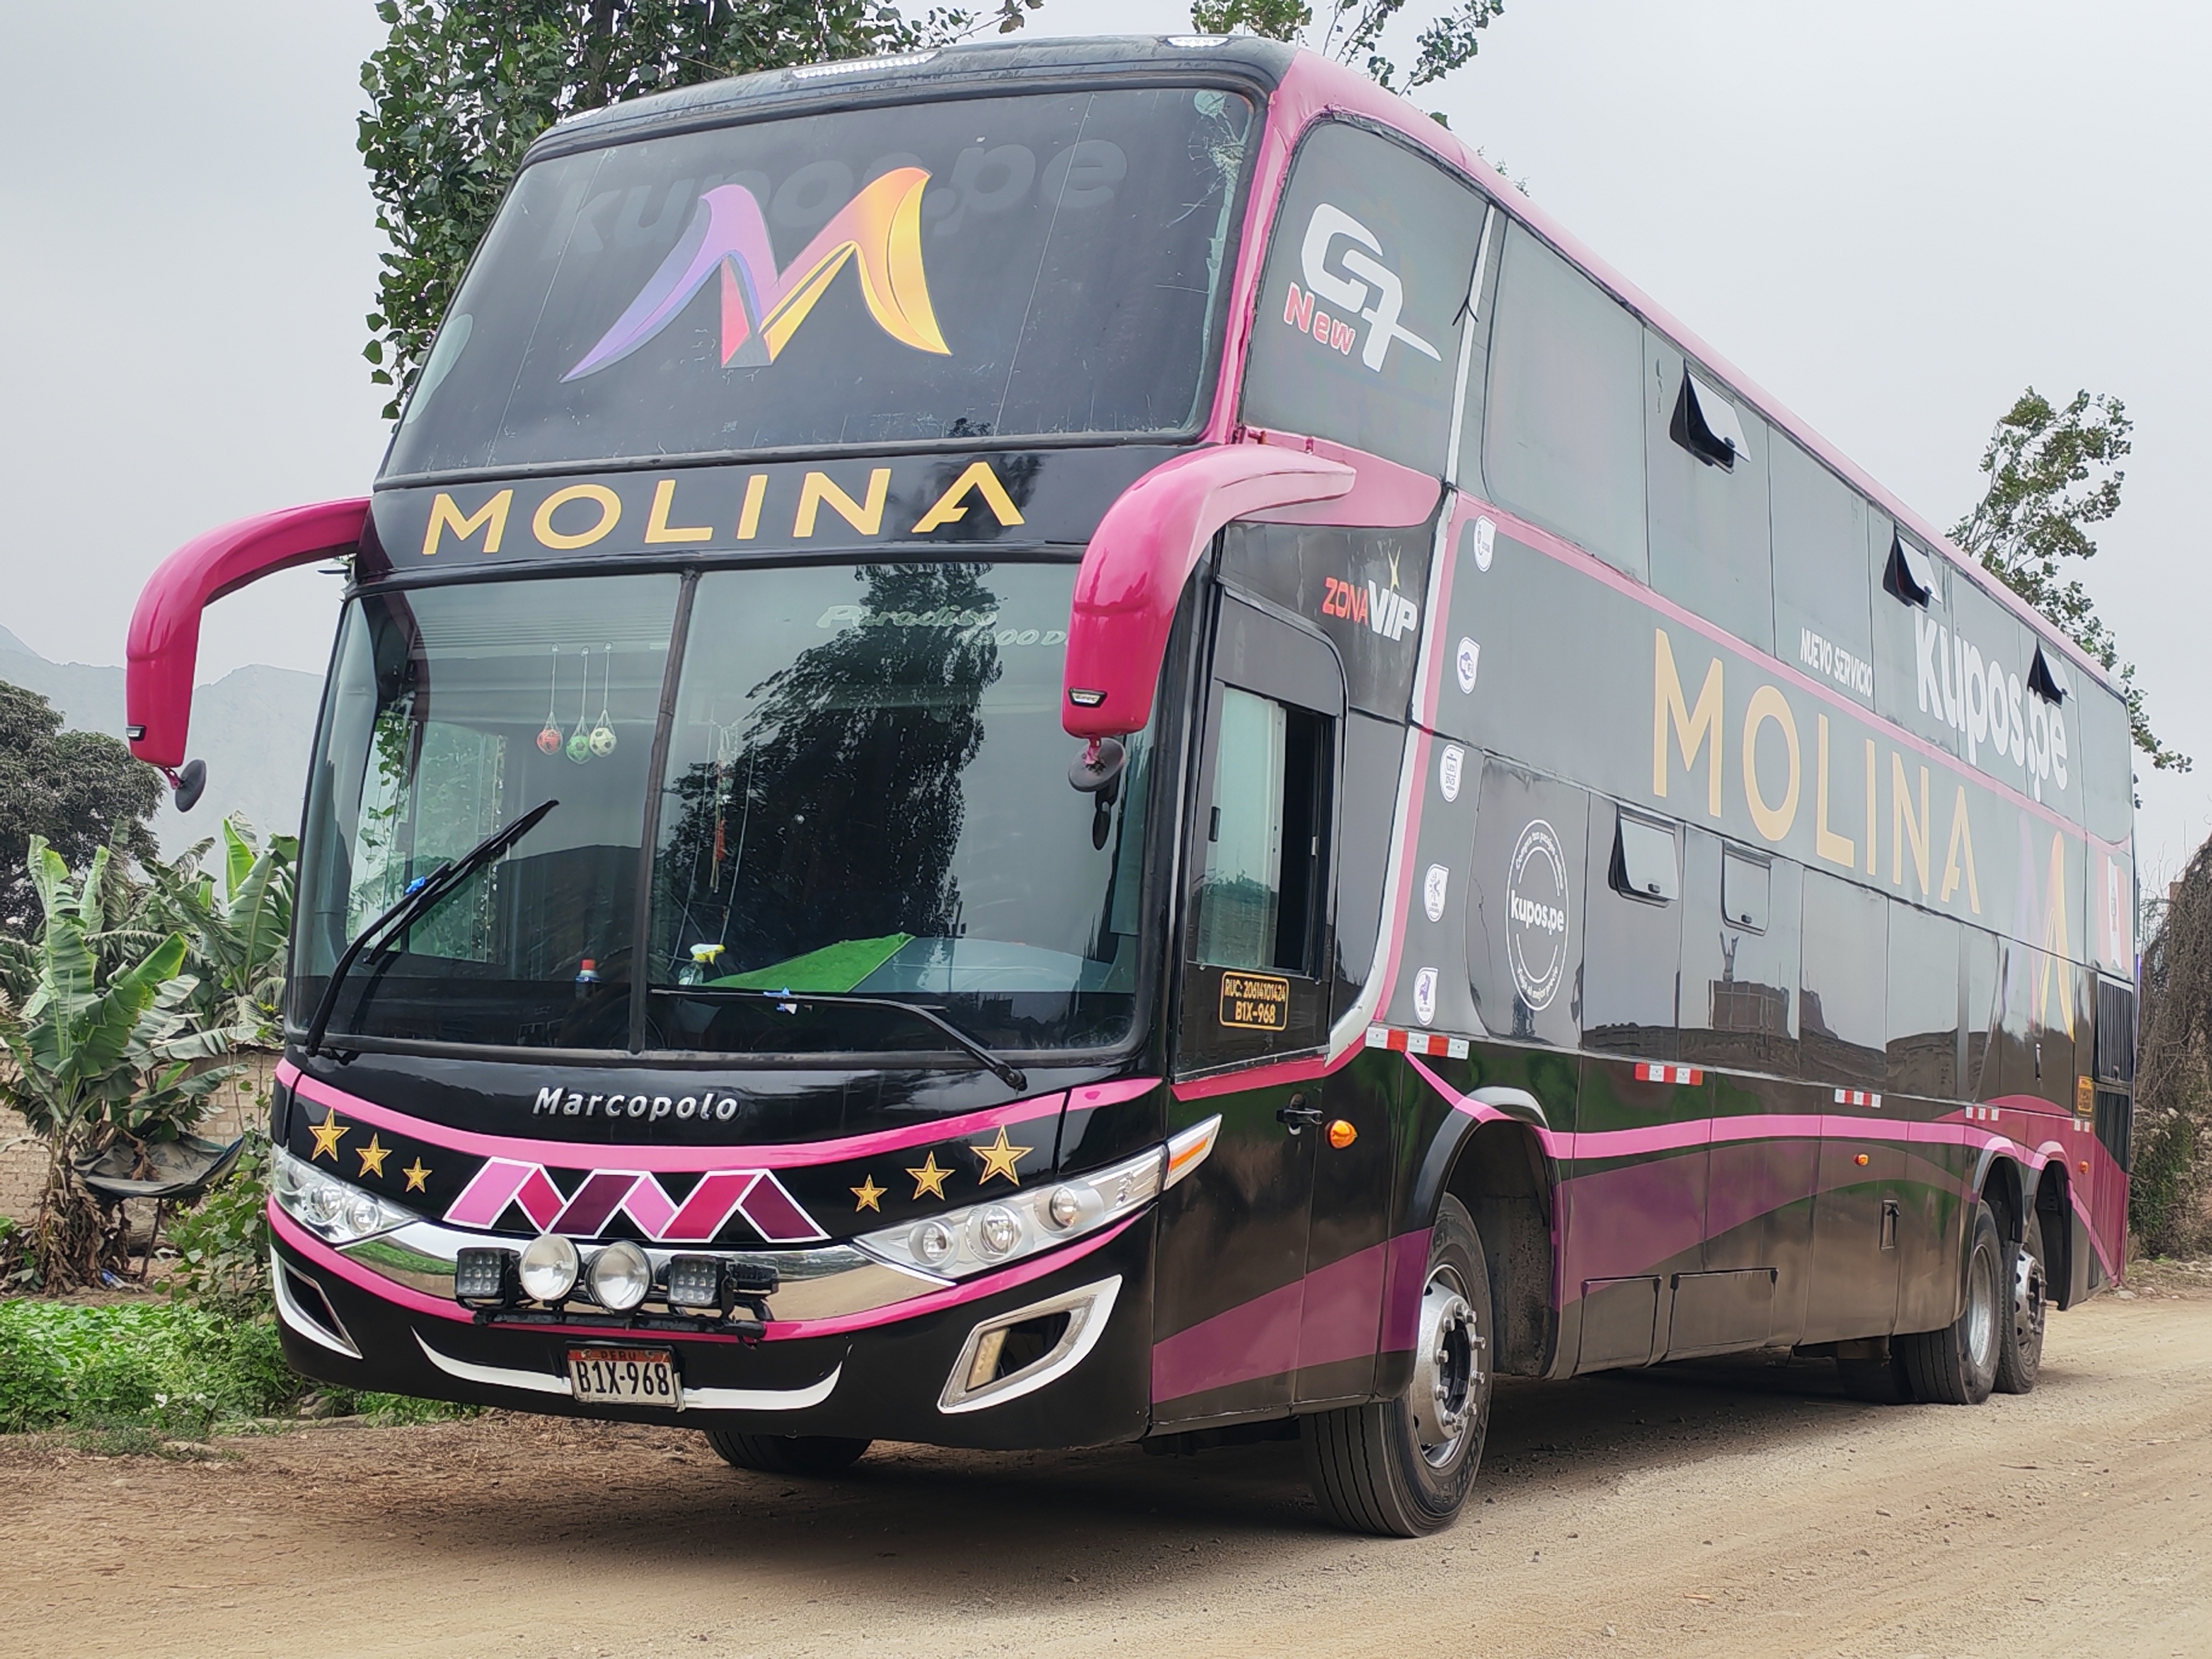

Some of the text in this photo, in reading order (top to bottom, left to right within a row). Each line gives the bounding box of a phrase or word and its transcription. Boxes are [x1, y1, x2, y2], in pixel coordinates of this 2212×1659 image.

[422, 462, 1025, 555] MOLINA
[1321, 577, 1368, 626] ZONA
[1800, 626, 1873, 698] NUEVO SERVICIO
[1653, 628, 1981, 914] MOLINA
[1511, 889, 1564, 935] kupos.pe
[532, 1087, 739, 1122] Marcopolo
[576, 1360, 670, 1395] B1X-968
